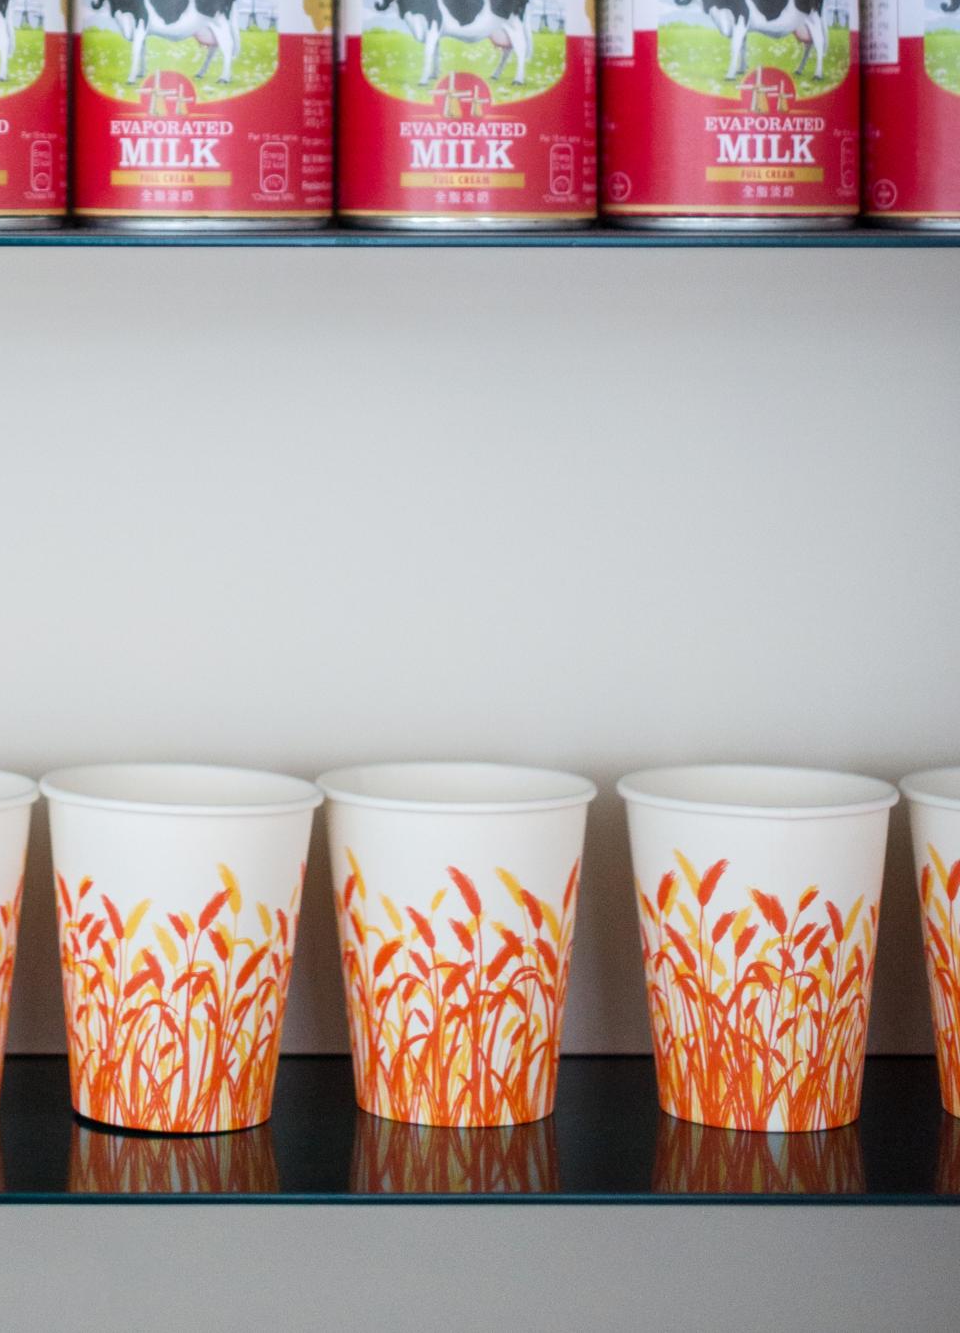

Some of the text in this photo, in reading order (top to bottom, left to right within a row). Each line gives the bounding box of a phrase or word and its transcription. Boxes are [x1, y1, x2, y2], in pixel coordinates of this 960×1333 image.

[110, 120, 234, 136] EVAPORATED
[400, 122, 526, 137] EVAPORATED
[705, 117, 825, 132] EVAPORATED
[119, 138, 220, 168] MILK
[410, 139, 514, 169] MILK
[716, 134, 815, 164] MILK
